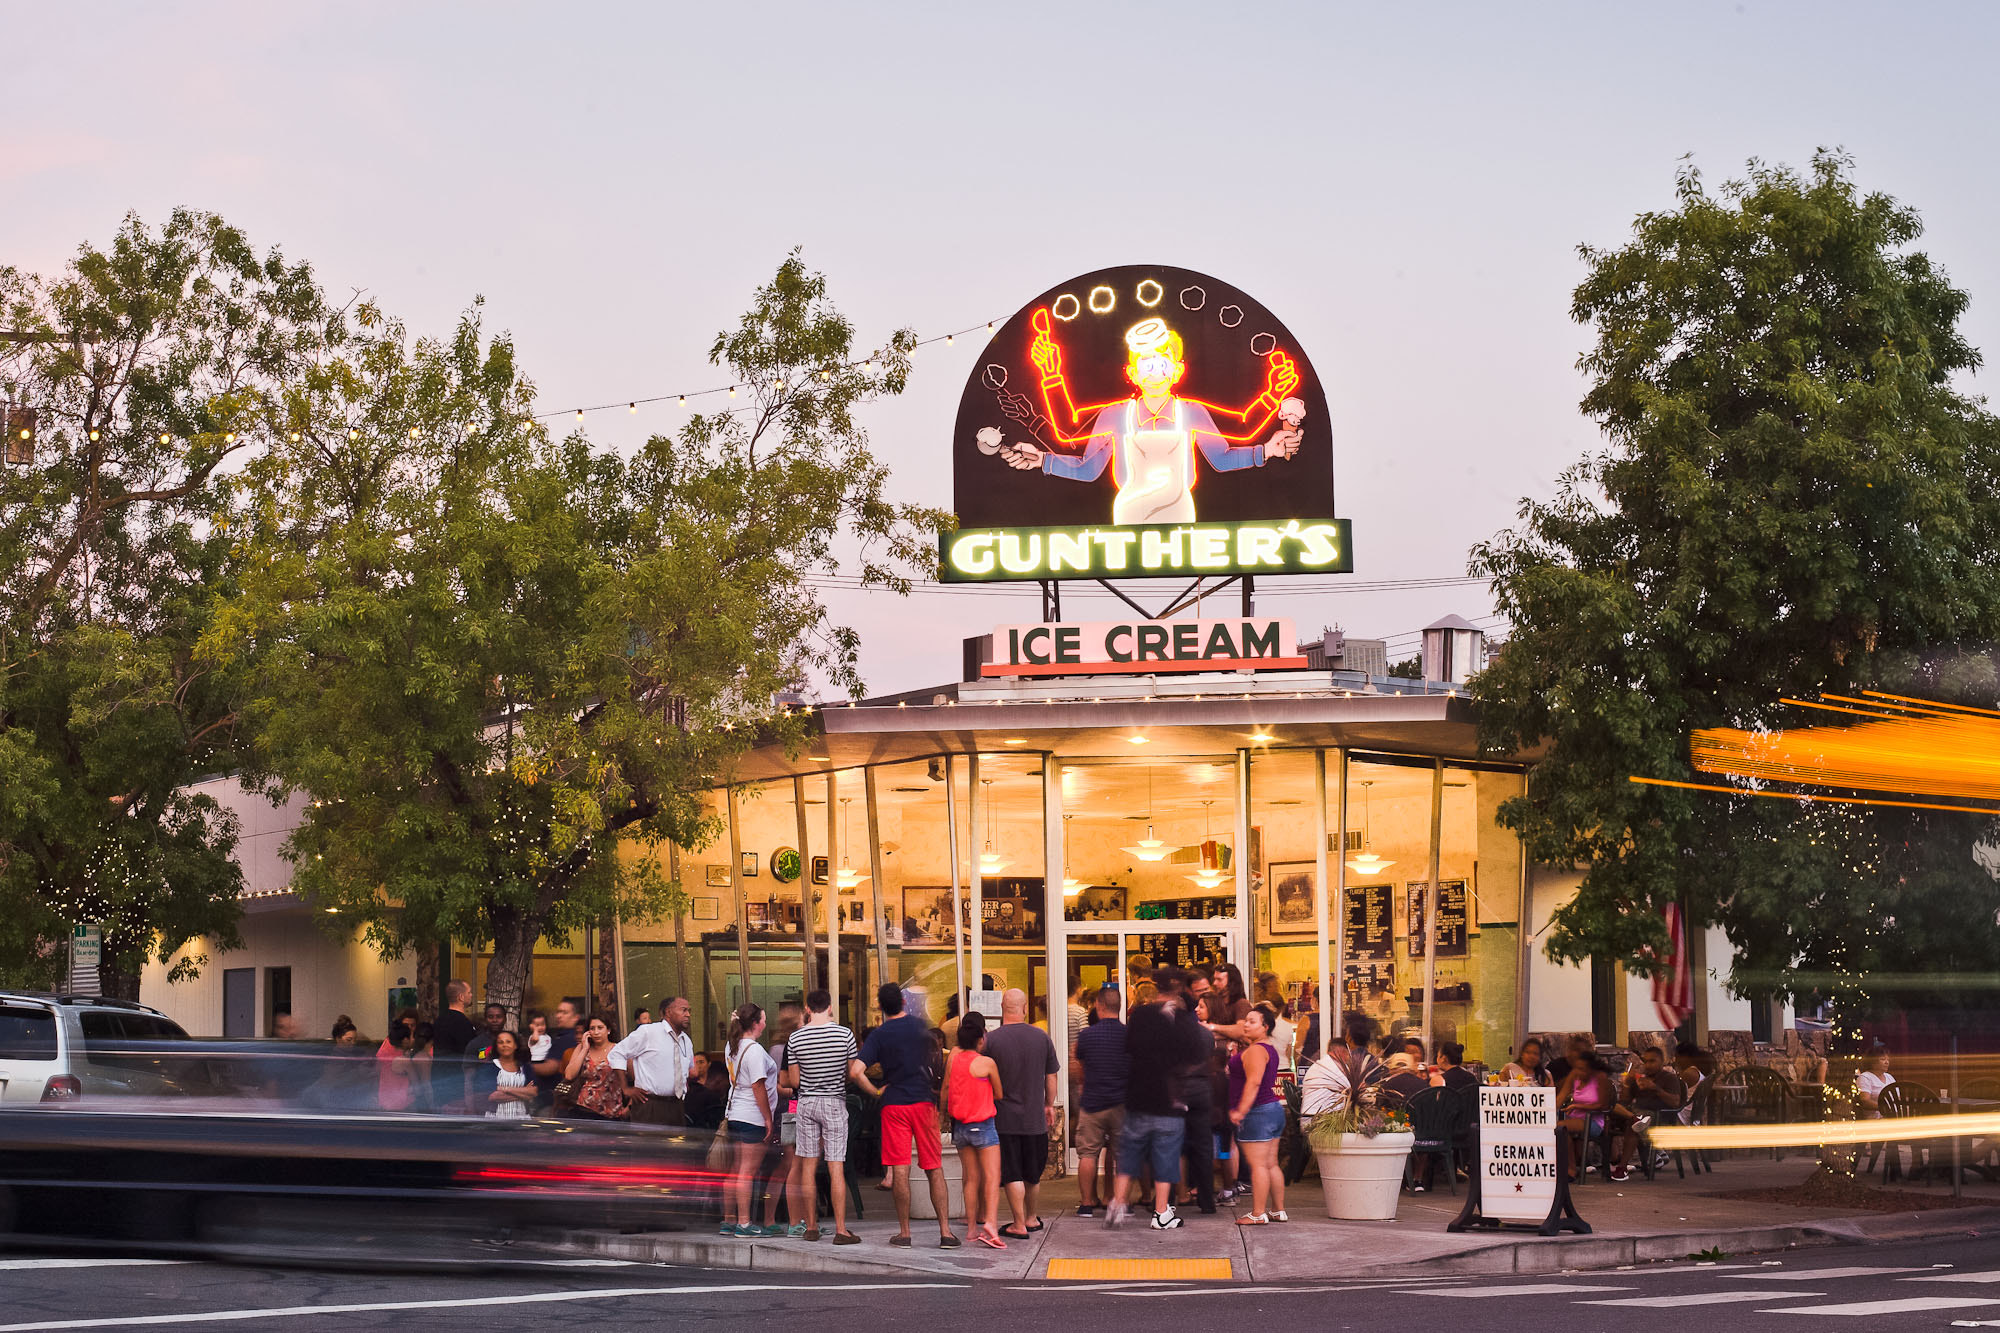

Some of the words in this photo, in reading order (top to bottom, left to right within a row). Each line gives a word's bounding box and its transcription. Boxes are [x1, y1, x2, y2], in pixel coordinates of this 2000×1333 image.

[951, 519, 1338, 574] GUNTHER'S
[1008, 627, 1081, 665] ICE
[1104, 621, 1281, 663] CREAM
[963, 901, 999, 910] ODER
[1134, 905, 1167, 919] 2801
[76, 939, 99, 948] PARKING
[1481, 1092, 1525, 1107] FLAVOR
[1531, 1093, 1545, 1108] OF
[1494, 1145, 1545, 1160] GERMAN
[1488, 1162, 1556, 1178] CHOCOLATE
